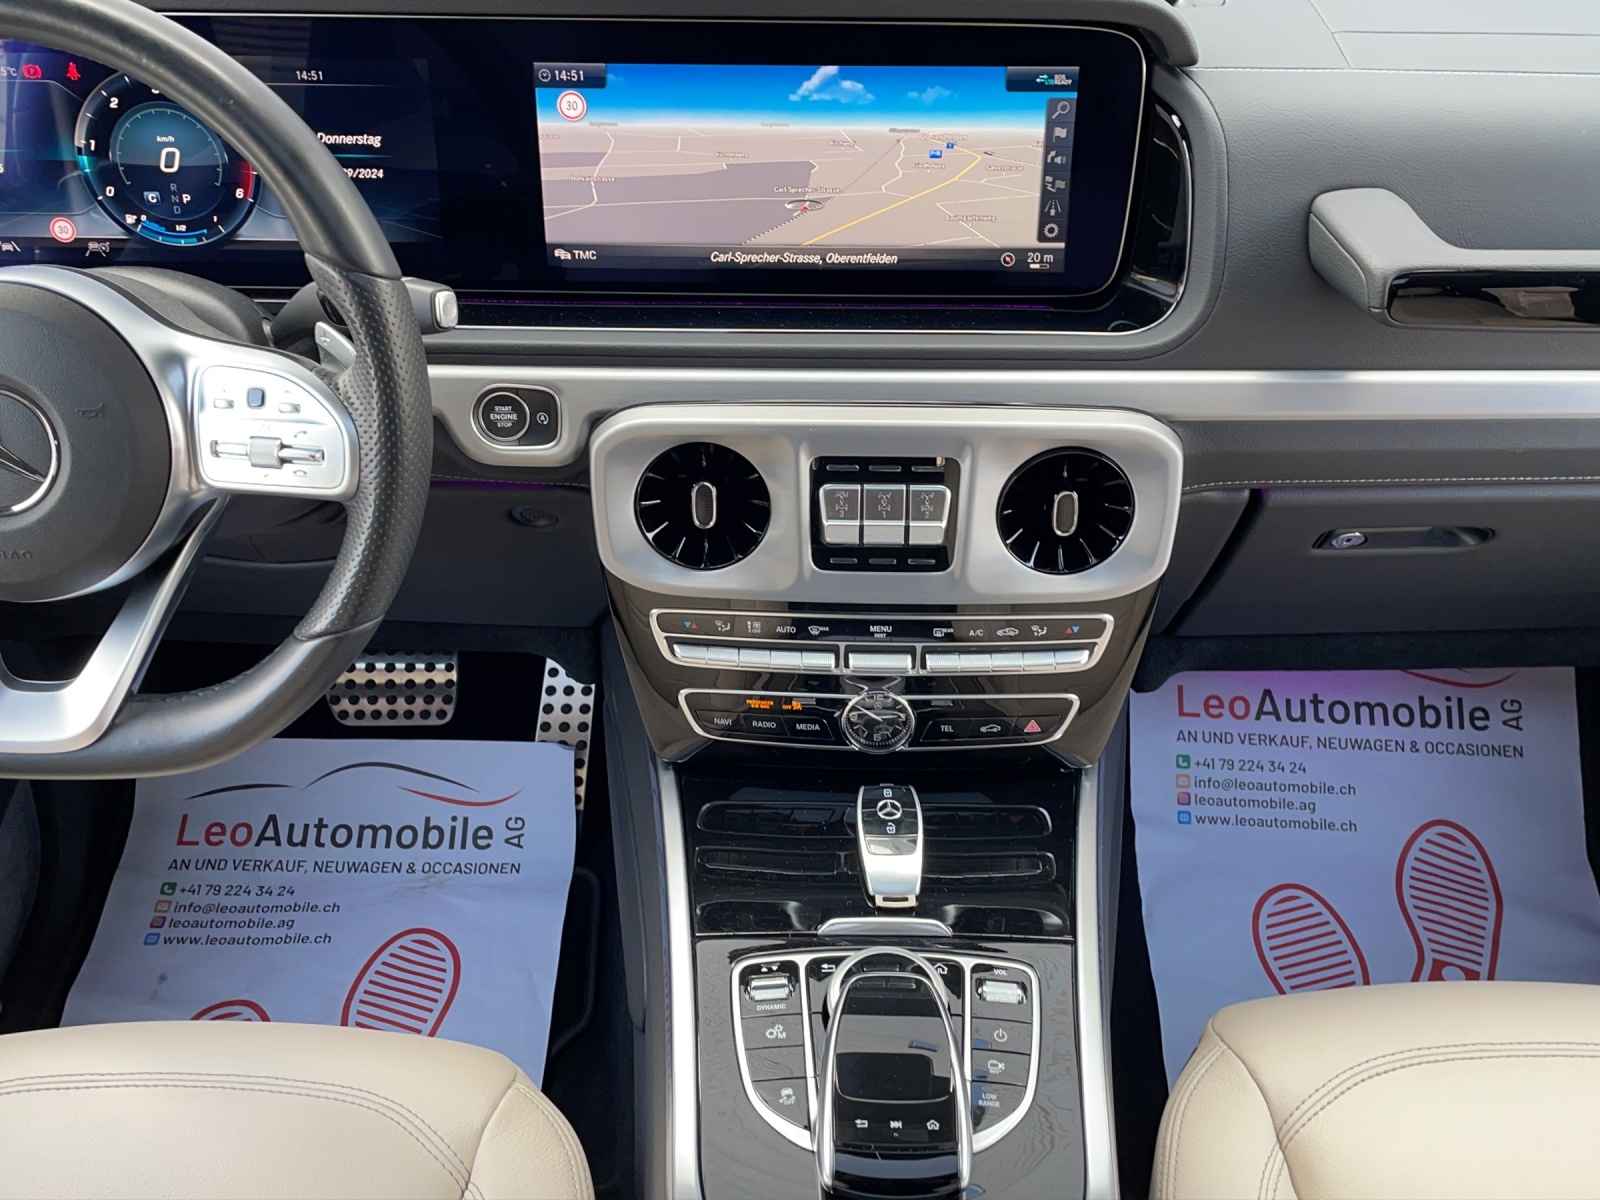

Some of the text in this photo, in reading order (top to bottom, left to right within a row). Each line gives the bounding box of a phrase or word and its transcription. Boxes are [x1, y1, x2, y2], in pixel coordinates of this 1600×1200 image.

[296, 70, 323, 81] 14:51
[554, 69, 585, 81] 14:51
[109, 97, 119, 109] 2
[565, 101, 578, 111] 30
[156, 135, 175, 143] km/h
[317, 132, 382, 148] Donnerstag
[89, 139, 96, 151] 1
[159, 147, 181, 173] 0
[105, 186, 115, 197] 0
[170, 183, 178, 192] R
[148, 193, 158, 203] C
[171, 194, 180, 203] N
[182, 193, 191, 205] P
[235, 188, 245, 199] 6
[173, 205, 182, 215] D
[57, 225, 69, 235] 30
[573, 250, 597, 260] TMC
[710, 251, 898, 266] Carl-Sprecher-Strasse, Oberentfelden
[1027, 252, 1054, 263] 20 m
[775, 625, 797, 634] AUTO
[869, 625, 893, 633] MENU
[968, 629, 984, 637] A/C
[1176, 684, 1523, 732] LeoAutomobile AG
[714, 717, 732, 726] NAVI
[752, 720, 777, 729] RADIO
[796, 723, 820, 731] MEDIA
[1176, 729, 1523, 758] AN UND VERKAUF, NEUWAGEN & OCCASIONEN
[1194, 757, 1307, 774] +41 79 224 34 24
[1194, 776, 1356, 795] info@leoautomobile.ch
[1194, 795, 1316, 814] leoautomobile.ag
[1195, 815, 1357, 832] www.leoautomobile.ch
[176, 813, 526, 850] LeoAutomobile AG
[167, 858, 521, 875] AN UND VERKAUF, NEUWAGEN & OCCASIONEN
[179, 884, 294, 897] +41 79 224 34 24
[173, 902, 340, 915] info@leoautomobile.ch
[168, 918, 295, 930] leoautomobile.ag
[163, 933, 332, 945] www.leoautomobile.ch
[993, 968, 1008, 976] VOL
[756, 1003, 787, 1011] DYNAMIC
[981, 1092, 997, 1100] LOW
[978, 1099, 1000, 1107] RANGE
